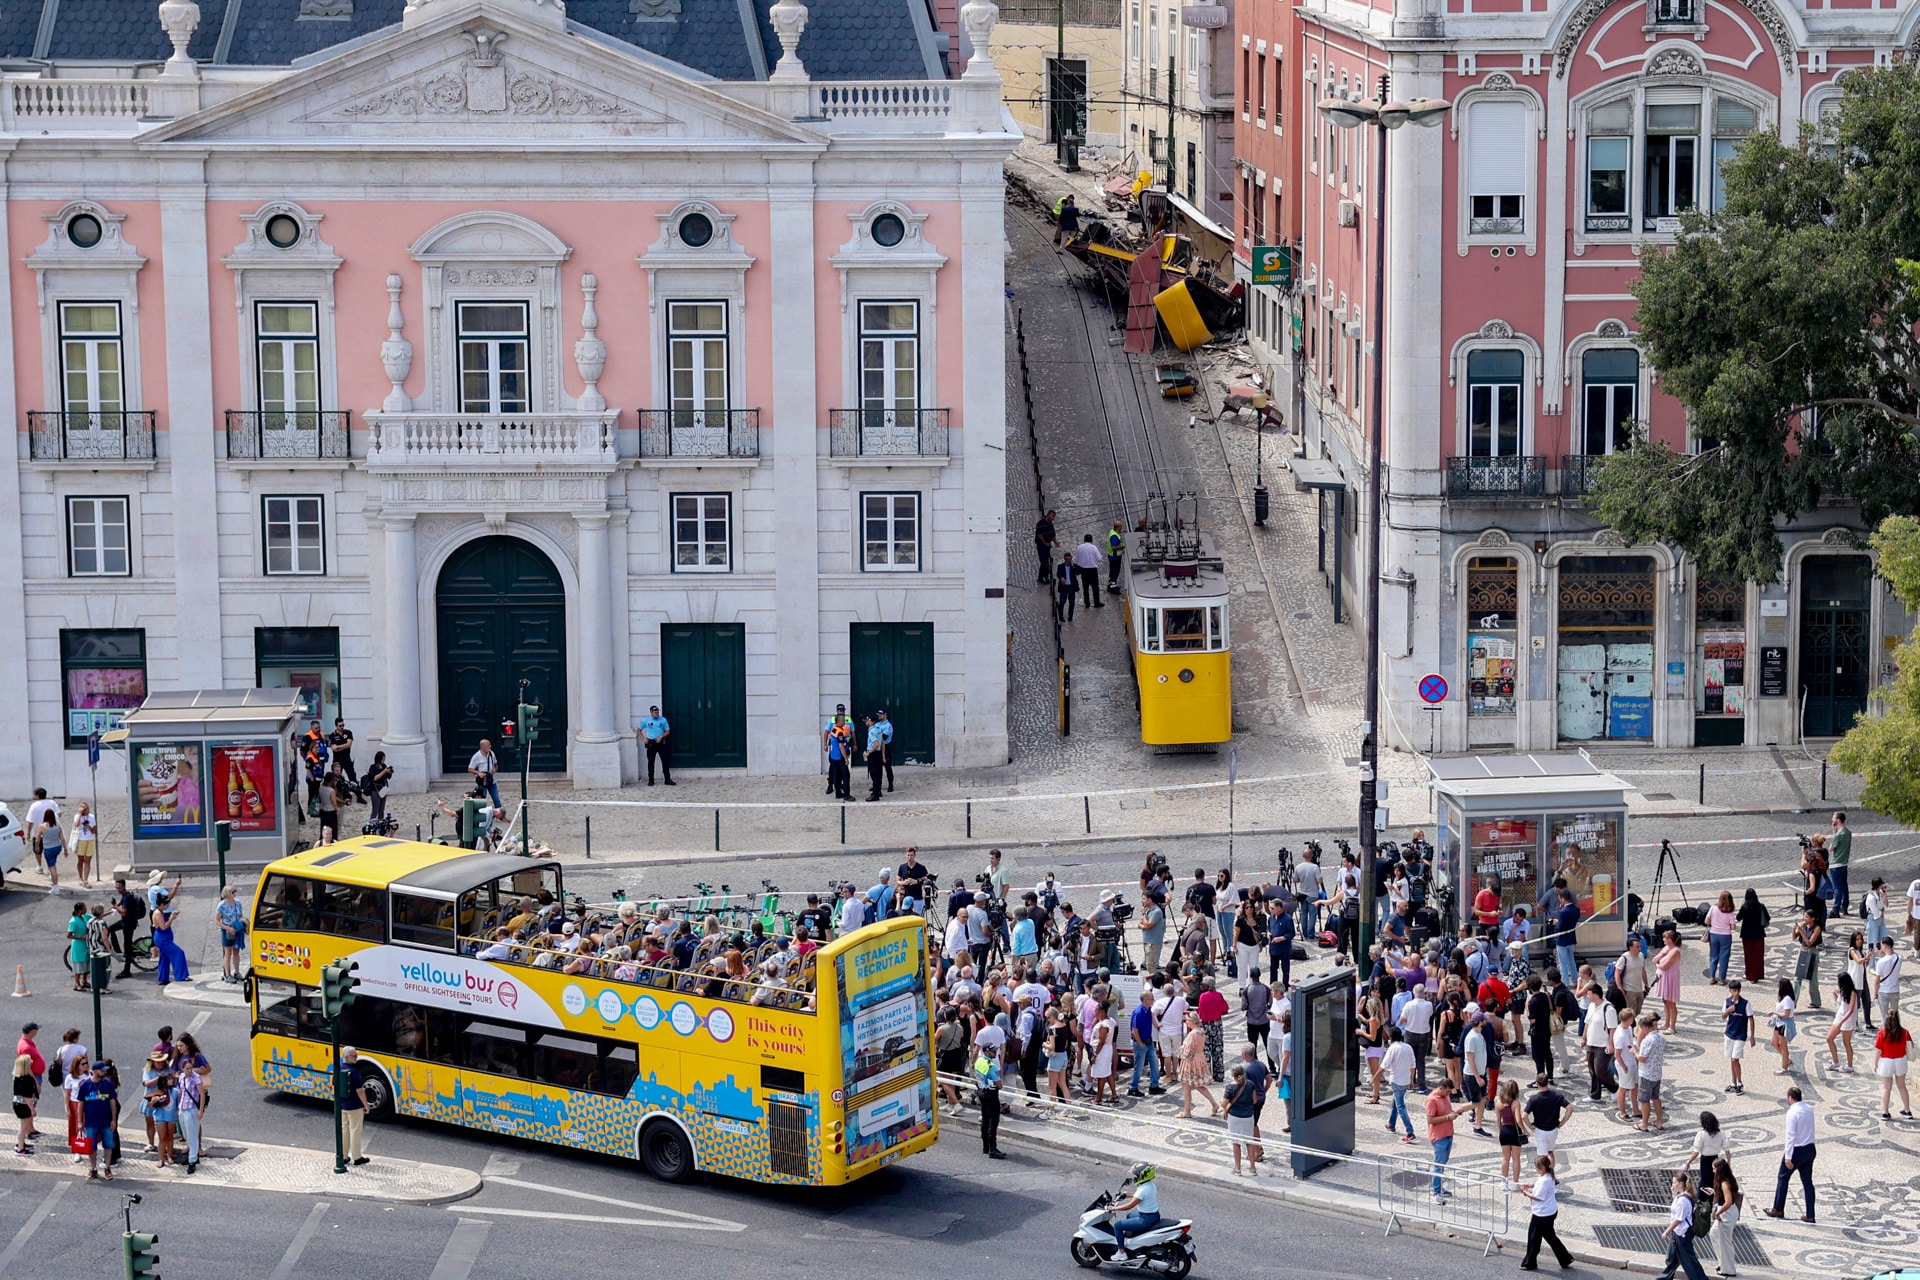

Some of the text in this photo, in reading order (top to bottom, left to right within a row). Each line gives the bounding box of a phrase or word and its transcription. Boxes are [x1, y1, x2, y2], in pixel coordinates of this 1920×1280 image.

[1188, 16, 1219, 26] TURIM
[1612, 701, 1650, 709] Rent-a-car
[1563, 821, 1605, 834] SER PORTUGUÊS
[1556, 834, 1567, 843] NÃO
[1568, 833, 1575, 842] SE
[1580, 840, 1606, 849] SENTE-SE
[1484, 850, 1525, 864] SER PORTUGUÊS
[1476, 863, 1488, 873] NÃO
[1488, 864, 1495, 872] SE
[1501, 868, 1526, 879] SENTE-SE
[854, 939, 908, 967] ESTAMOS A
[857, 952, 907, 979] RECRUTAR
[465, 969, 494, 992] bus
[405, 982, 430, 994] OFFICIAL
[431, 987, 471, 1000] SIGHTSEEING
[472, 994, 493, 1004] TOURS
[857, 1004, 911, 1031] FAZEMOS PARTE DA
[746, 1016, 804, 1041] This city
[857, 1013, 913, 1041] HISTÓRIA DA CIDADE
[747, 1034, 806, 1056] is yours!
[291, 1079, 313, 1089] MADEIRA
[779, 1091, 798, 1101] BRAGA
[412, 1104, 430, 1112] LISBOA
[493, 1119, 516, 1129] COIMBRA
[715, 1121, 749, 1134] GUIMARÃES
[565, 1130, 585, 1140] PORTO
